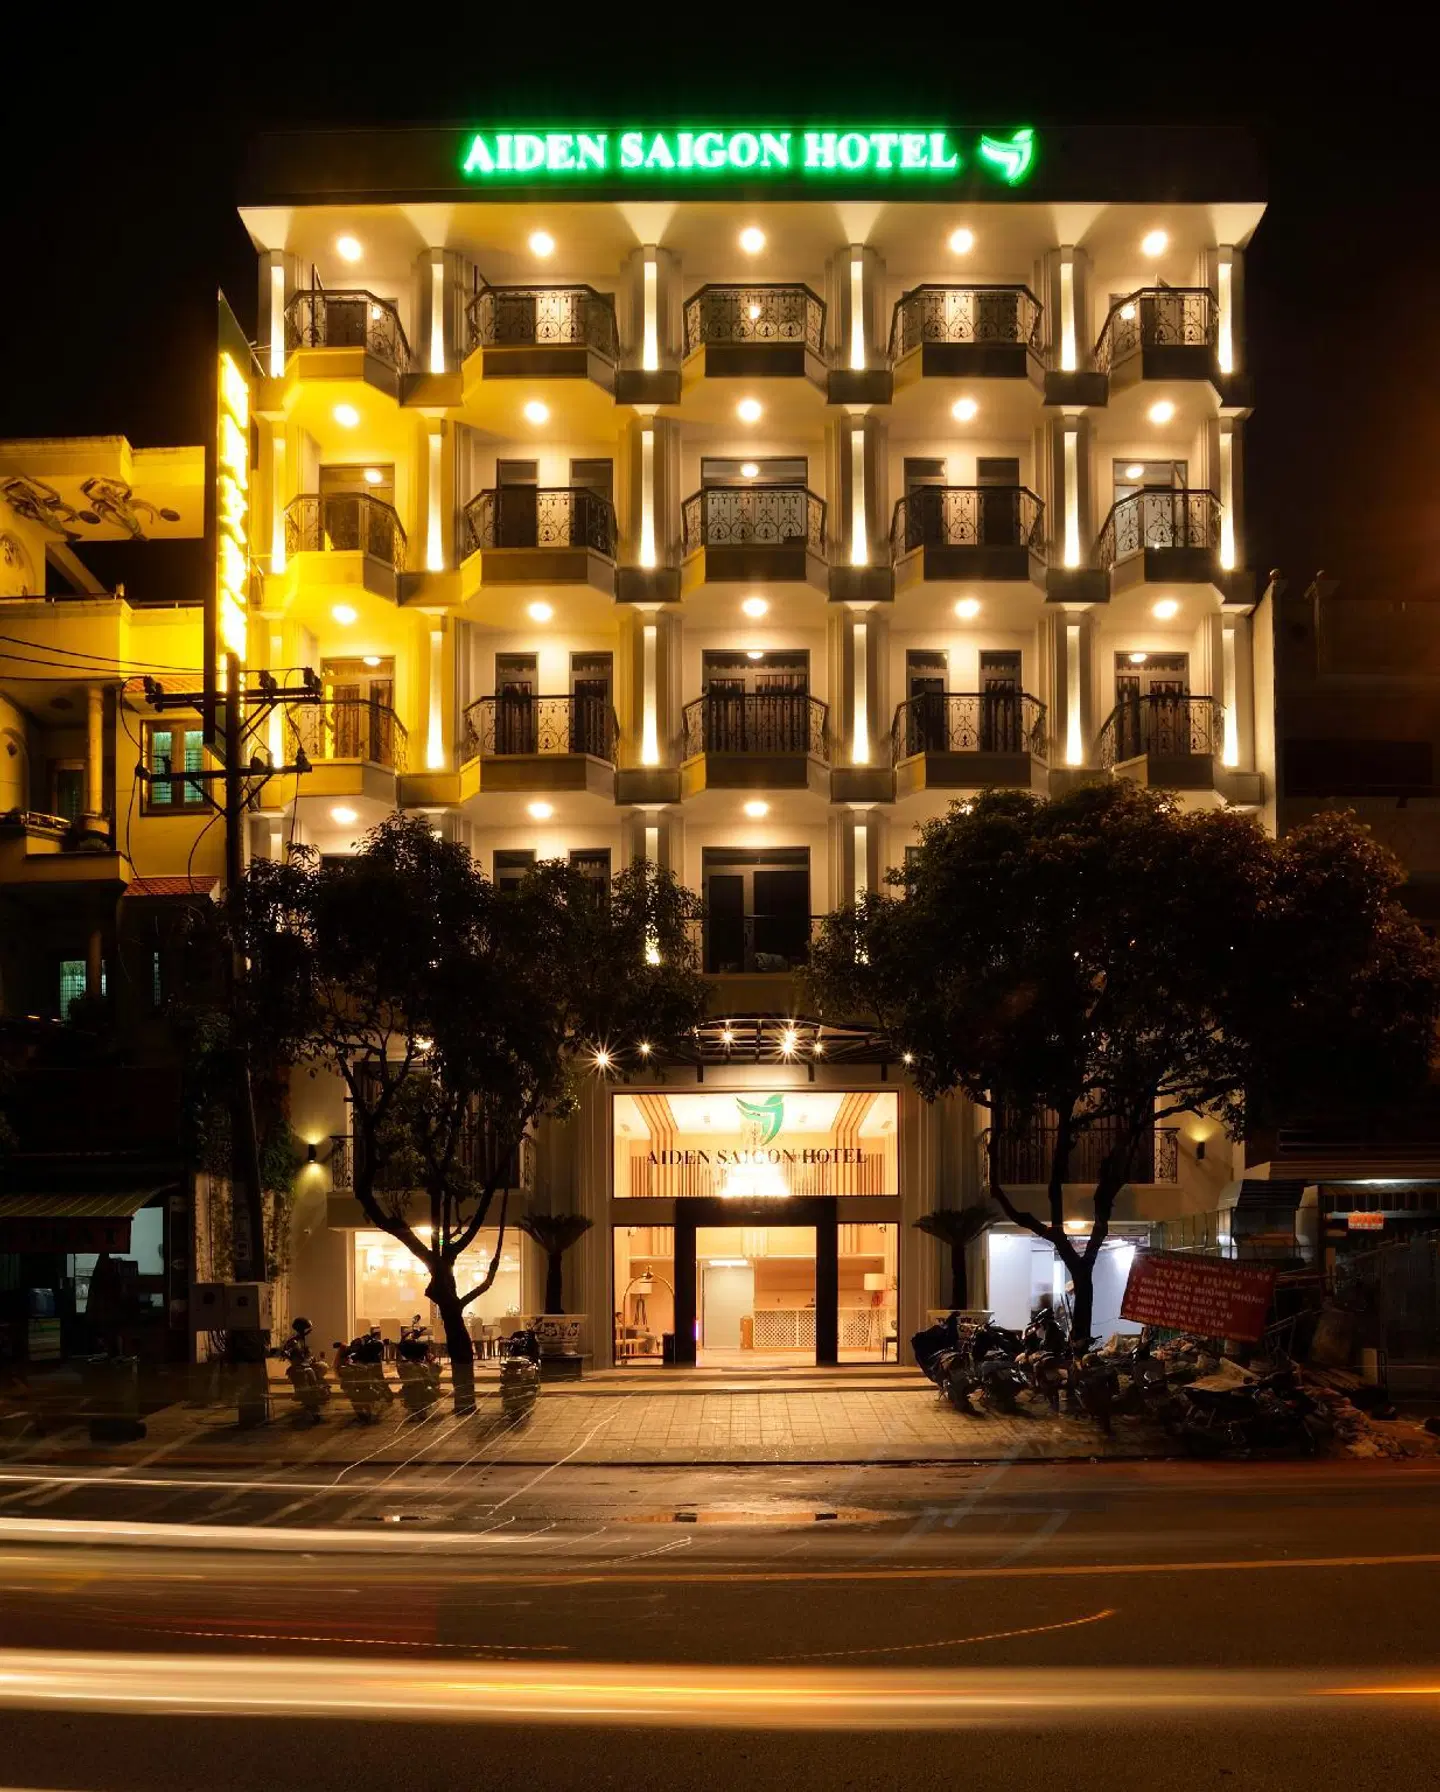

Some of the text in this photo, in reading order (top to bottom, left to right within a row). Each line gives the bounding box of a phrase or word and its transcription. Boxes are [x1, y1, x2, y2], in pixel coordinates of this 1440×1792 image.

[463, 131, 957, 172] AIDEN SAIGON HOTEL
[647, 1147, 868, 1165] AIDEN SAIGON HOTEL
